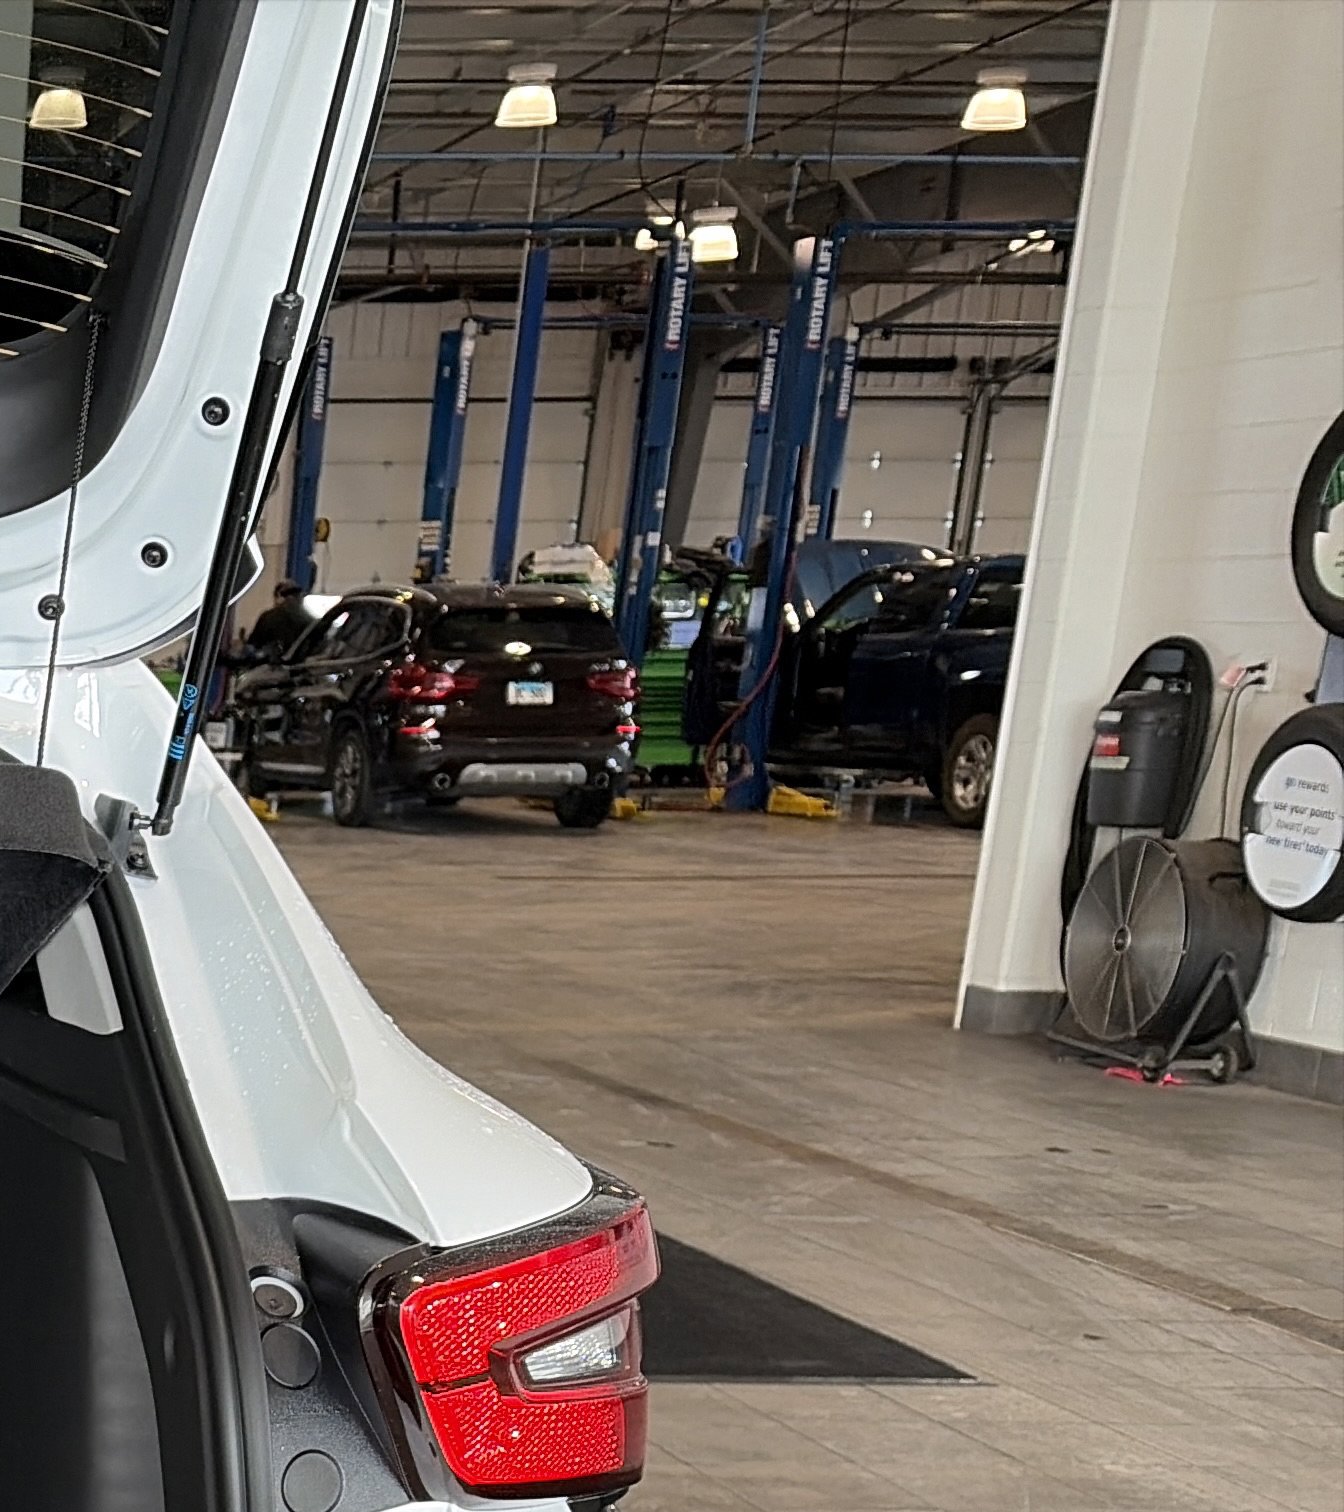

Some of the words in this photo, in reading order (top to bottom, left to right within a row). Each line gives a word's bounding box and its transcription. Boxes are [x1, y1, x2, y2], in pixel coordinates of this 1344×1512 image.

[674, 240, 691, 273] LIFT
[816, 240, 833, 273] LIFT
[668, 277, 687, 341] ROTARY
[809, 276, 828, 341] ROTARY
[765, 328, 781, 354] LIFT
[844, 342, 856, 361] LIF
[313, 366, 327, 413] ROTARY
[457, 360, 470, 408] ROTARY
[760, 356, 776, 406] ROTARY
[839, 364, 854, 411] ROTARY
[1297, 779, 1330, 794] rewards
[1273, 801, 1288, 811] use
[1289, 804, 1309, 816] your
[1309, 807, 1335, 821] points
[1302, 824, 1321, 836] your
[1265, 835, 1282, 846] new
[1305, 842, 1329, 859] today
